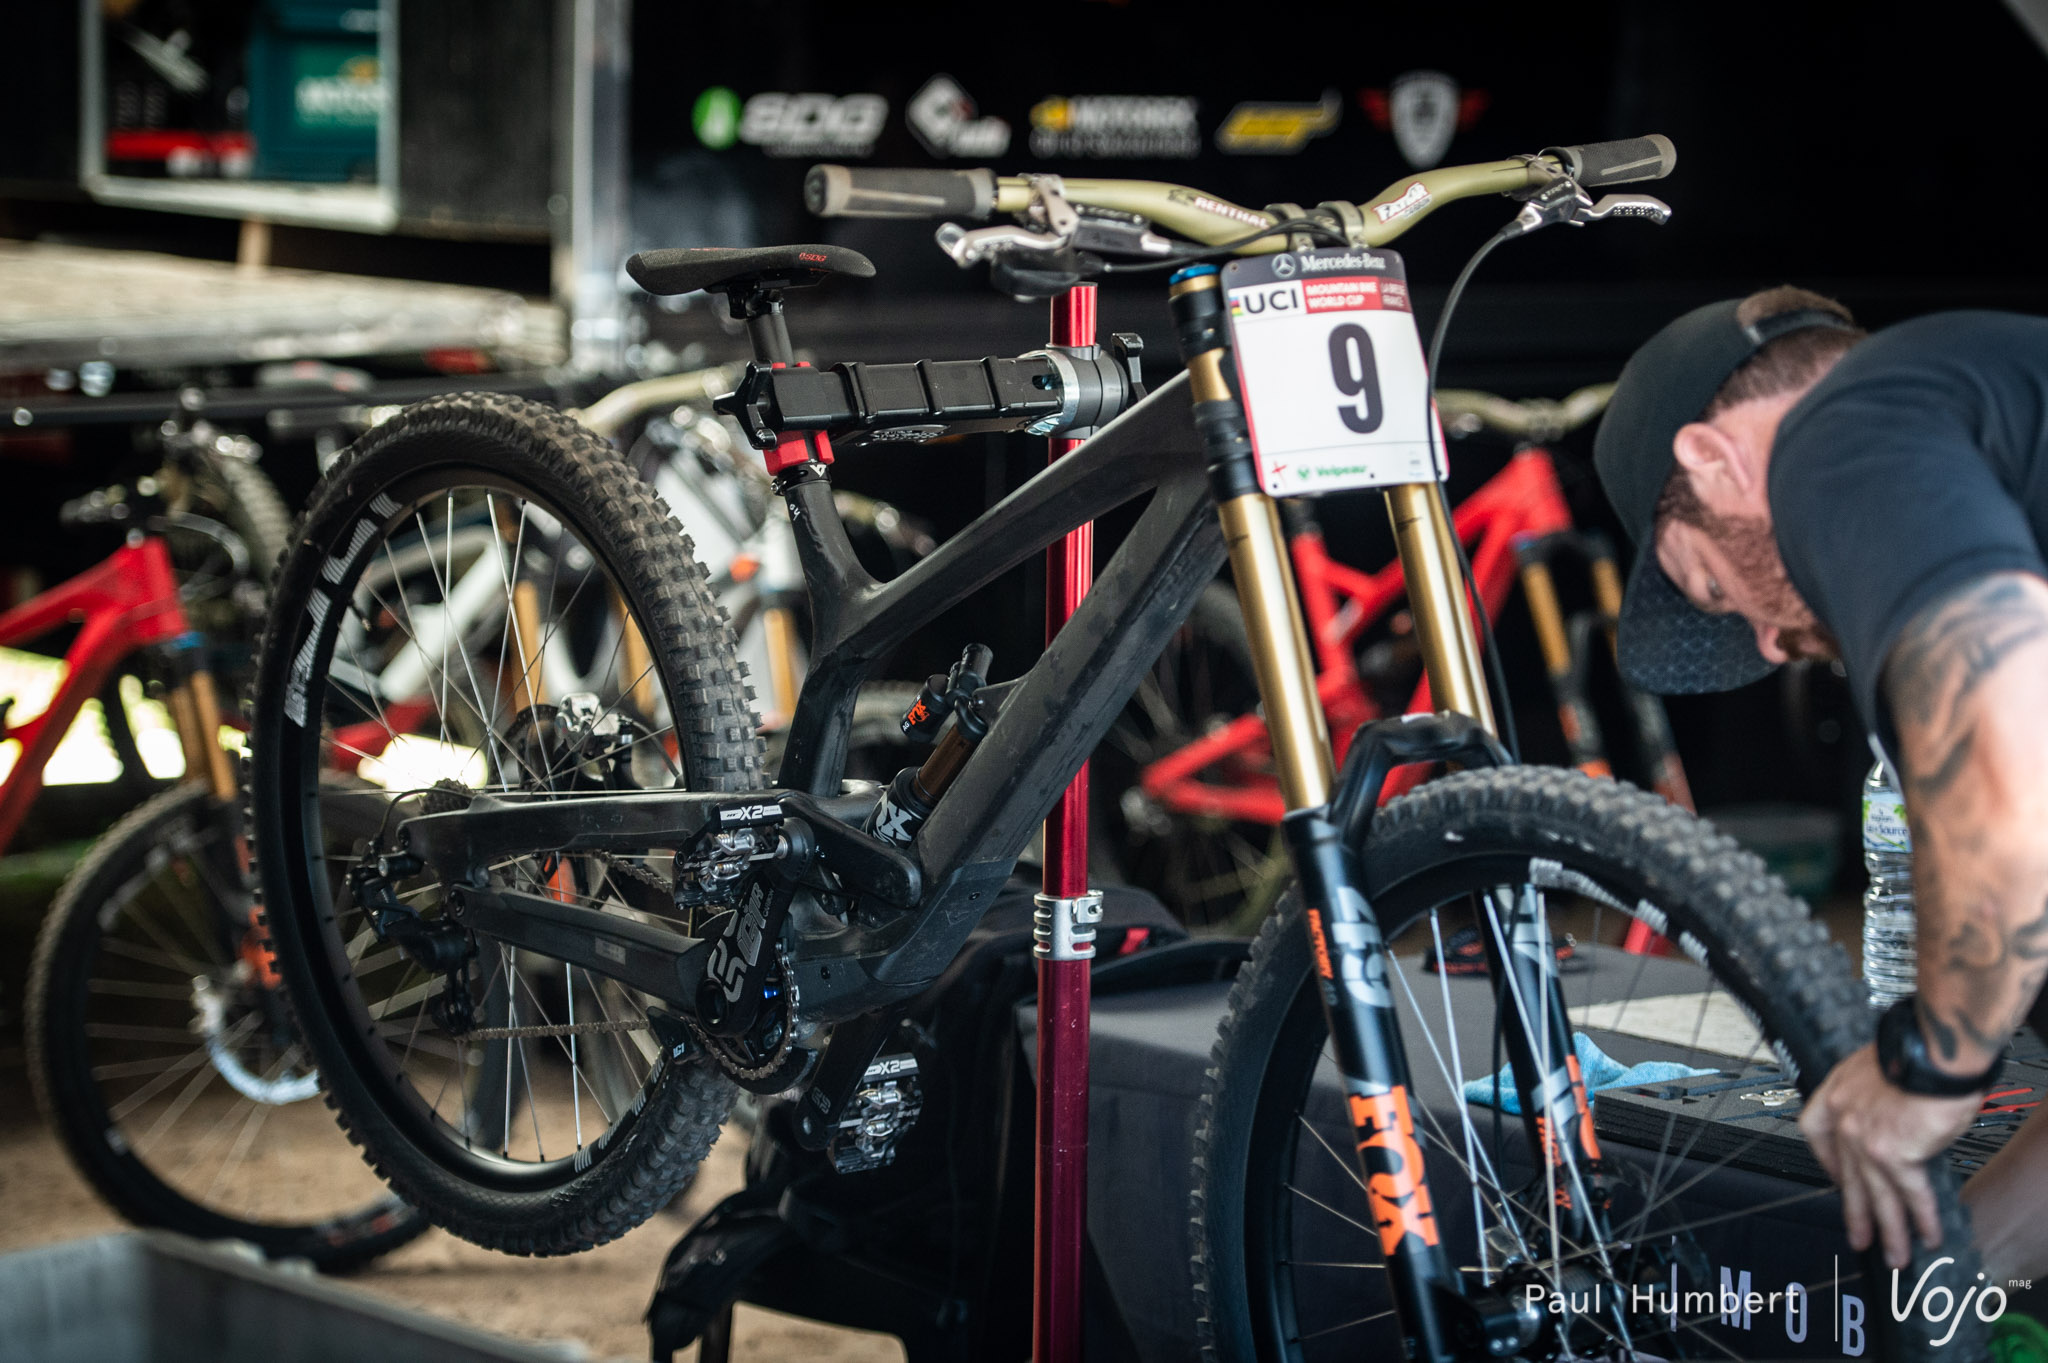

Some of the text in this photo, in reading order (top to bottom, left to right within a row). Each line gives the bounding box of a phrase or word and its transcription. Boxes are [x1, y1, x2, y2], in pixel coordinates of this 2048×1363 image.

[1195, 196, 1269, 230] RENTHAL
[1301, 253, 1386, 272] Mercedes-Benz
[1244, 288, 1299, 314] UCI
[1306, 283, 1358, 297] MOUNTAIN
[1308, 294, 1366, 310] WORLD CUP
[1328, 322, 1384, 435] 9
[907, 699, 928, 726] FOX
[740, 805, 763, 821] X2
[880, 1059, 901, 1075] X2
[1349, 1084, 1440, 1256] FOX
